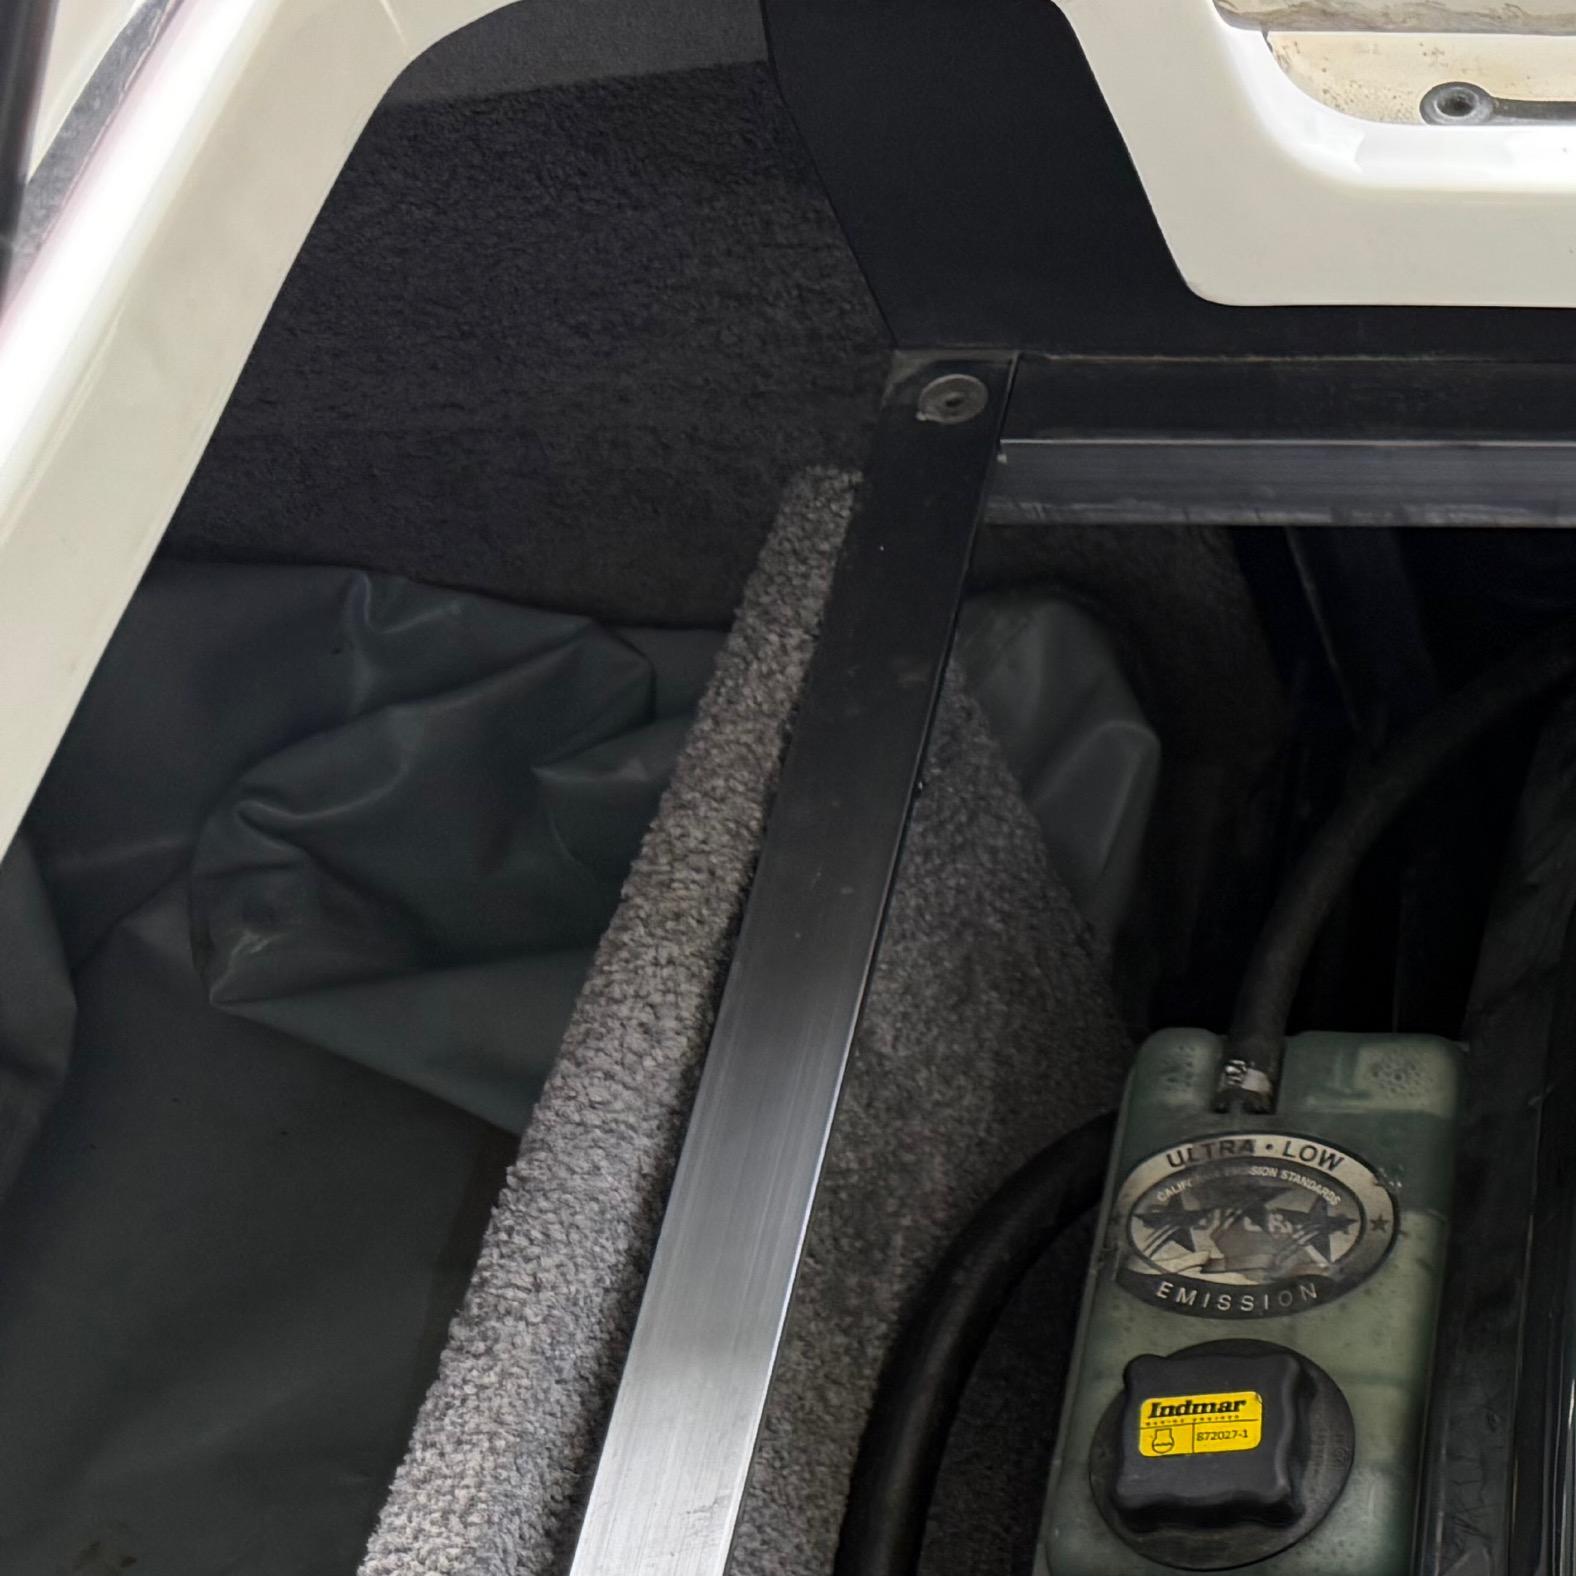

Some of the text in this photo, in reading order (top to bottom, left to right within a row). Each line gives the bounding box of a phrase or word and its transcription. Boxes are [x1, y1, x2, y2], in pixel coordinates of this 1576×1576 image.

[1166, 1139, 1344, 1172] ULTRA LOW
[1156, 1168, 1221, 1202] CALIF
[1279, 1169, 1341, 1206] STANDARDS
[1155, 1280, 1318, 1312] EMISSION
[1147, 1399, 1247, 1419] Indmar
